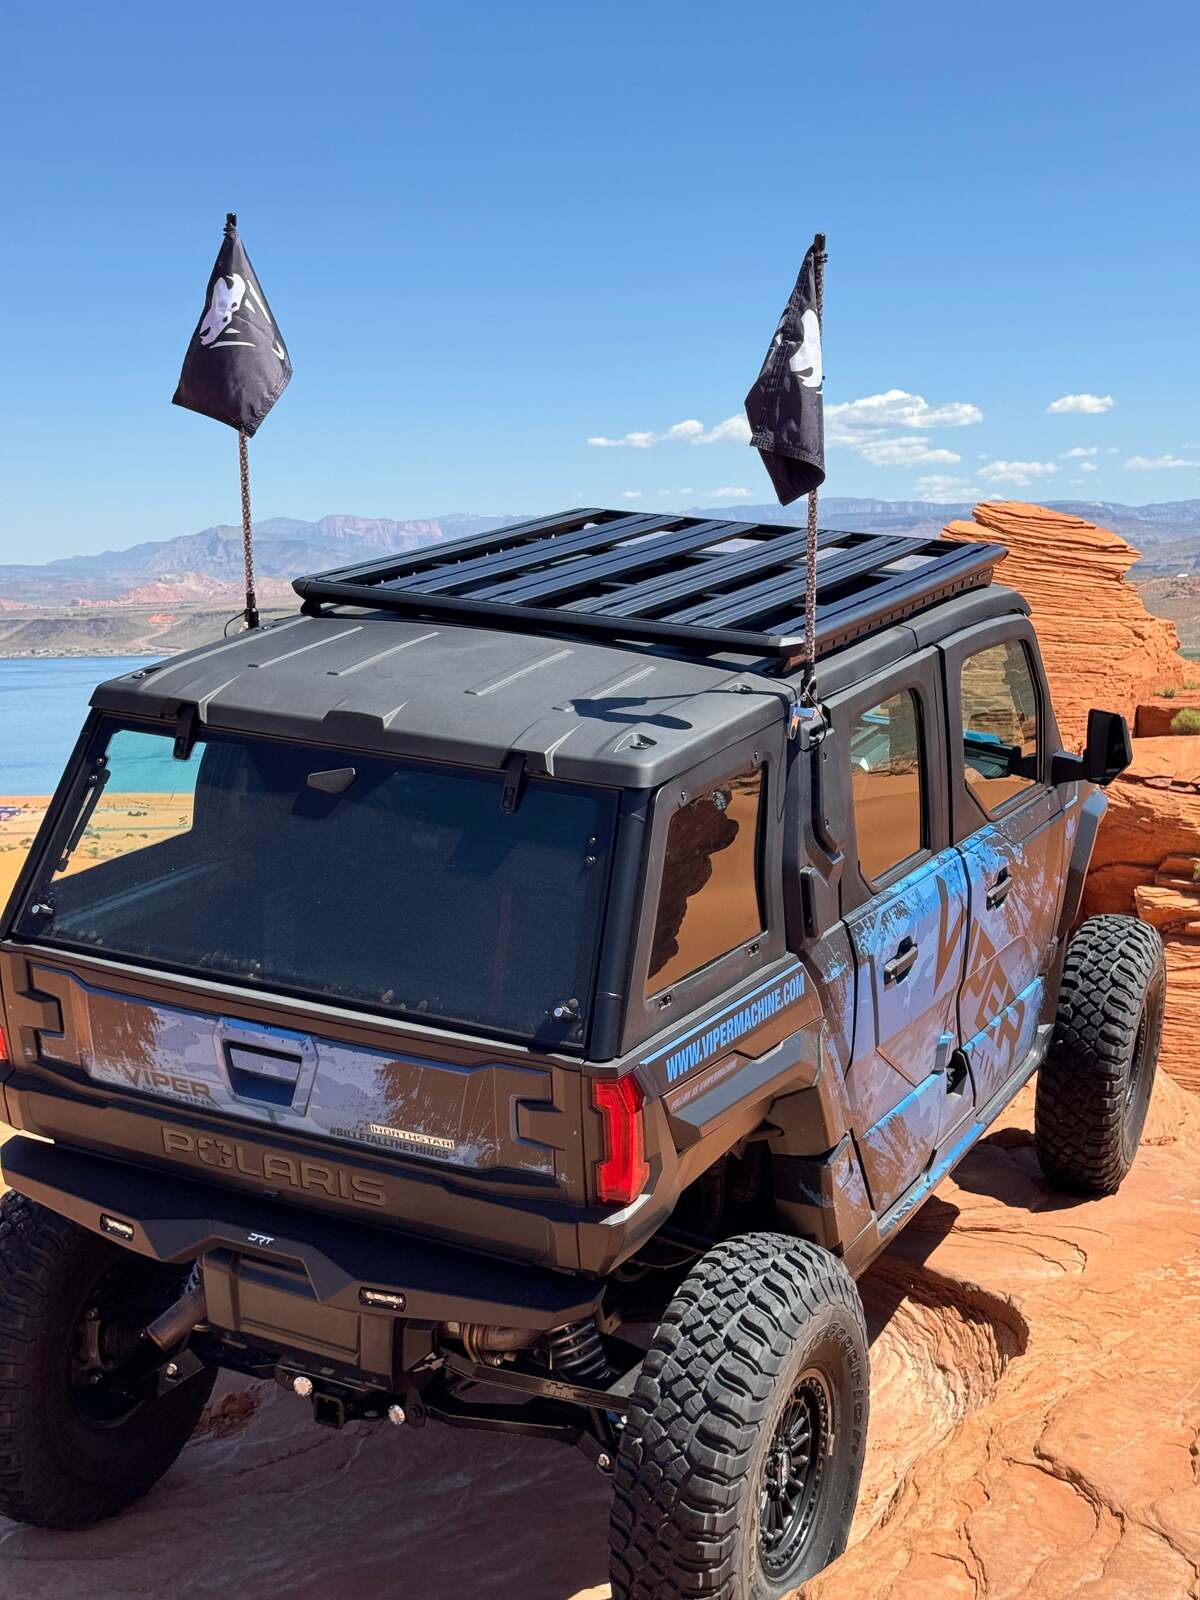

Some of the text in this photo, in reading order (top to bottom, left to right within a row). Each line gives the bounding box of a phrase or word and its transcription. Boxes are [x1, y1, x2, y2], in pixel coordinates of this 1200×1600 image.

[933, 874, 1025, 1072] VIPER
[665, 972, 805, 1083] WWW.VIPERMACHINE.COM
[120, 1064, 222, 1107] VIPER
[161, 1126, 388, 1207] POLARIS
[329, 1126, 449, 1159] #BILLETALLTHETHINGS
[373, 1125, 452, 1148] NORTHSTAR
